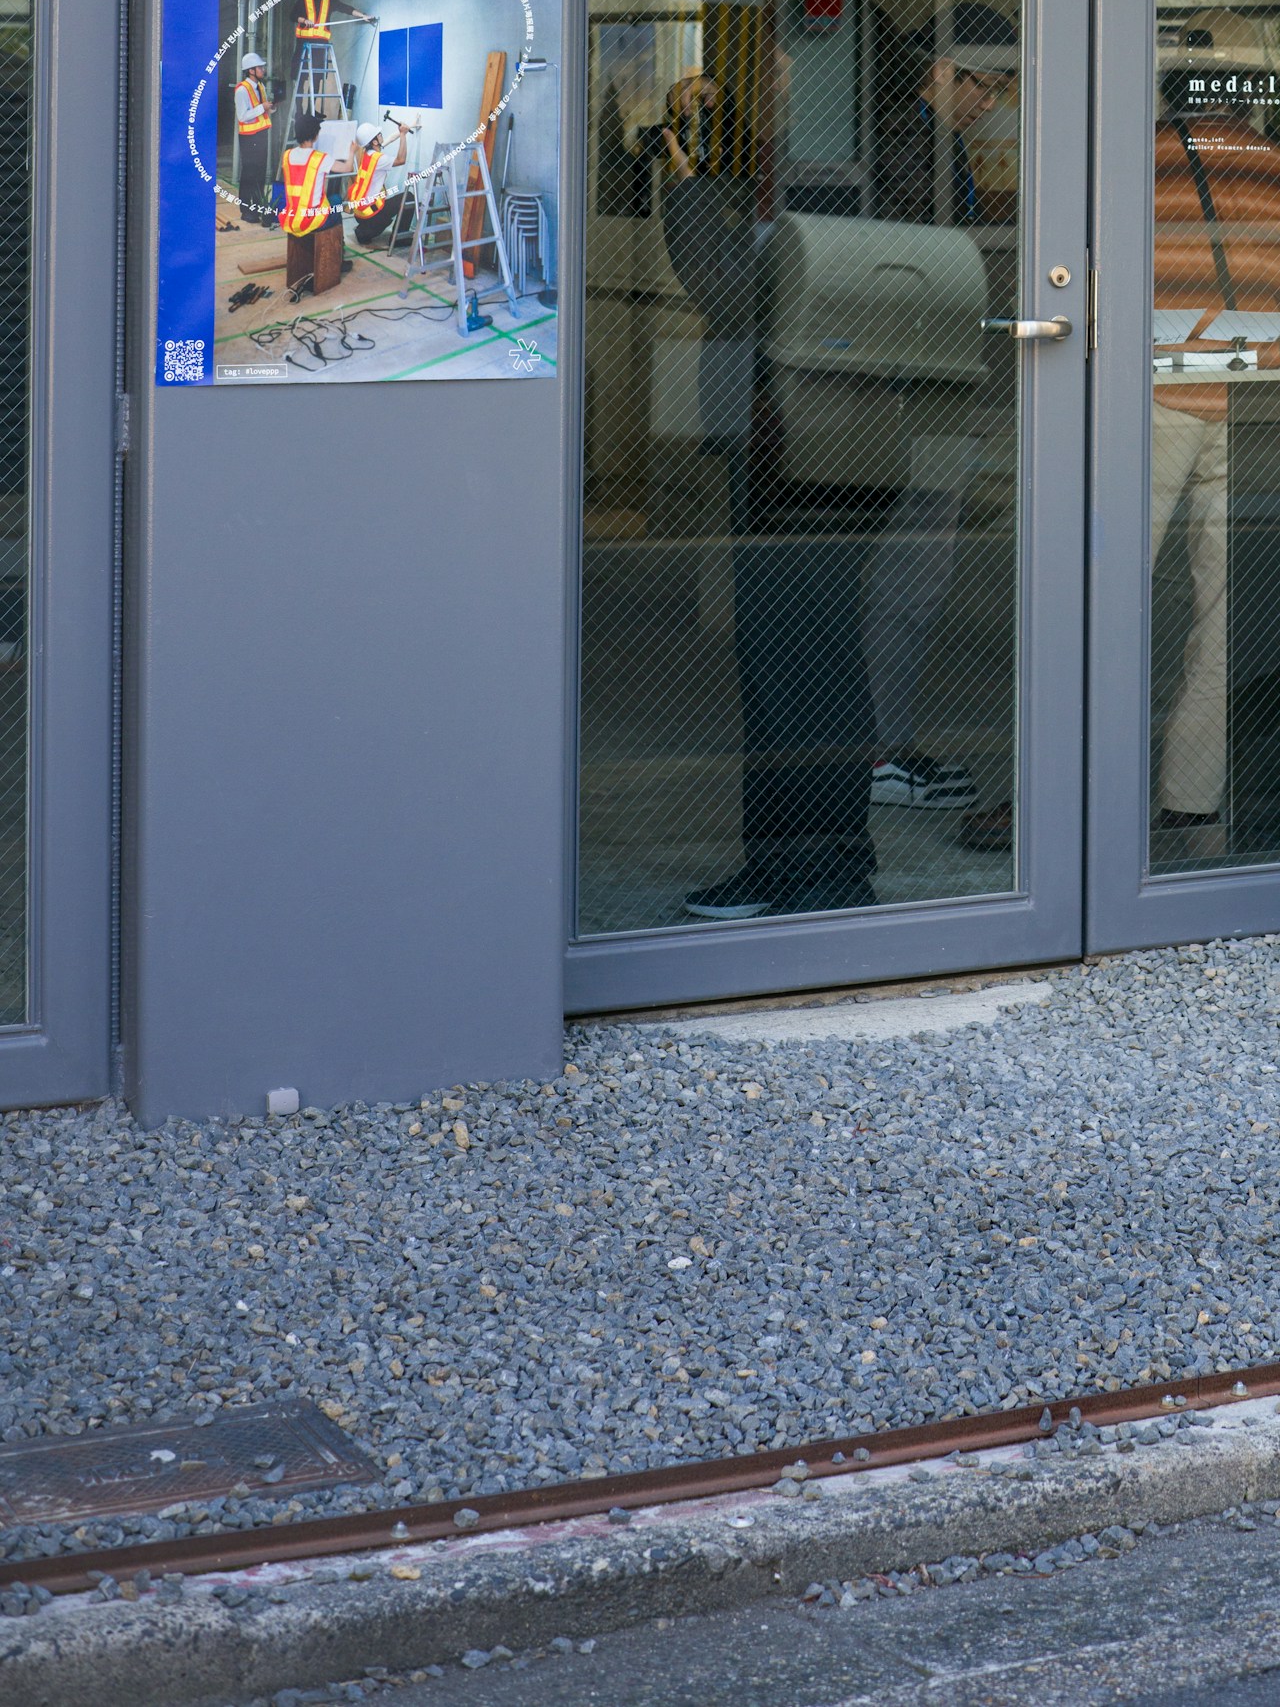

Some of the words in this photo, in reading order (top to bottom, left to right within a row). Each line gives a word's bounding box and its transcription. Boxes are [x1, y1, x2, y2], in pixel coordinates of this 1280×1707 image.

[188, 79, 207, 124] exhibition
[187, 125, 199, 156] poster
[466, 122, 487, 144] photo
[442, 141, 467, 165] poster
[194, 157, 213, 183] photo
[404, 161, 442, 186] exhibition
[224, 368, 241, 377] tag:
[246, 367, 280, 376] #loveppp
